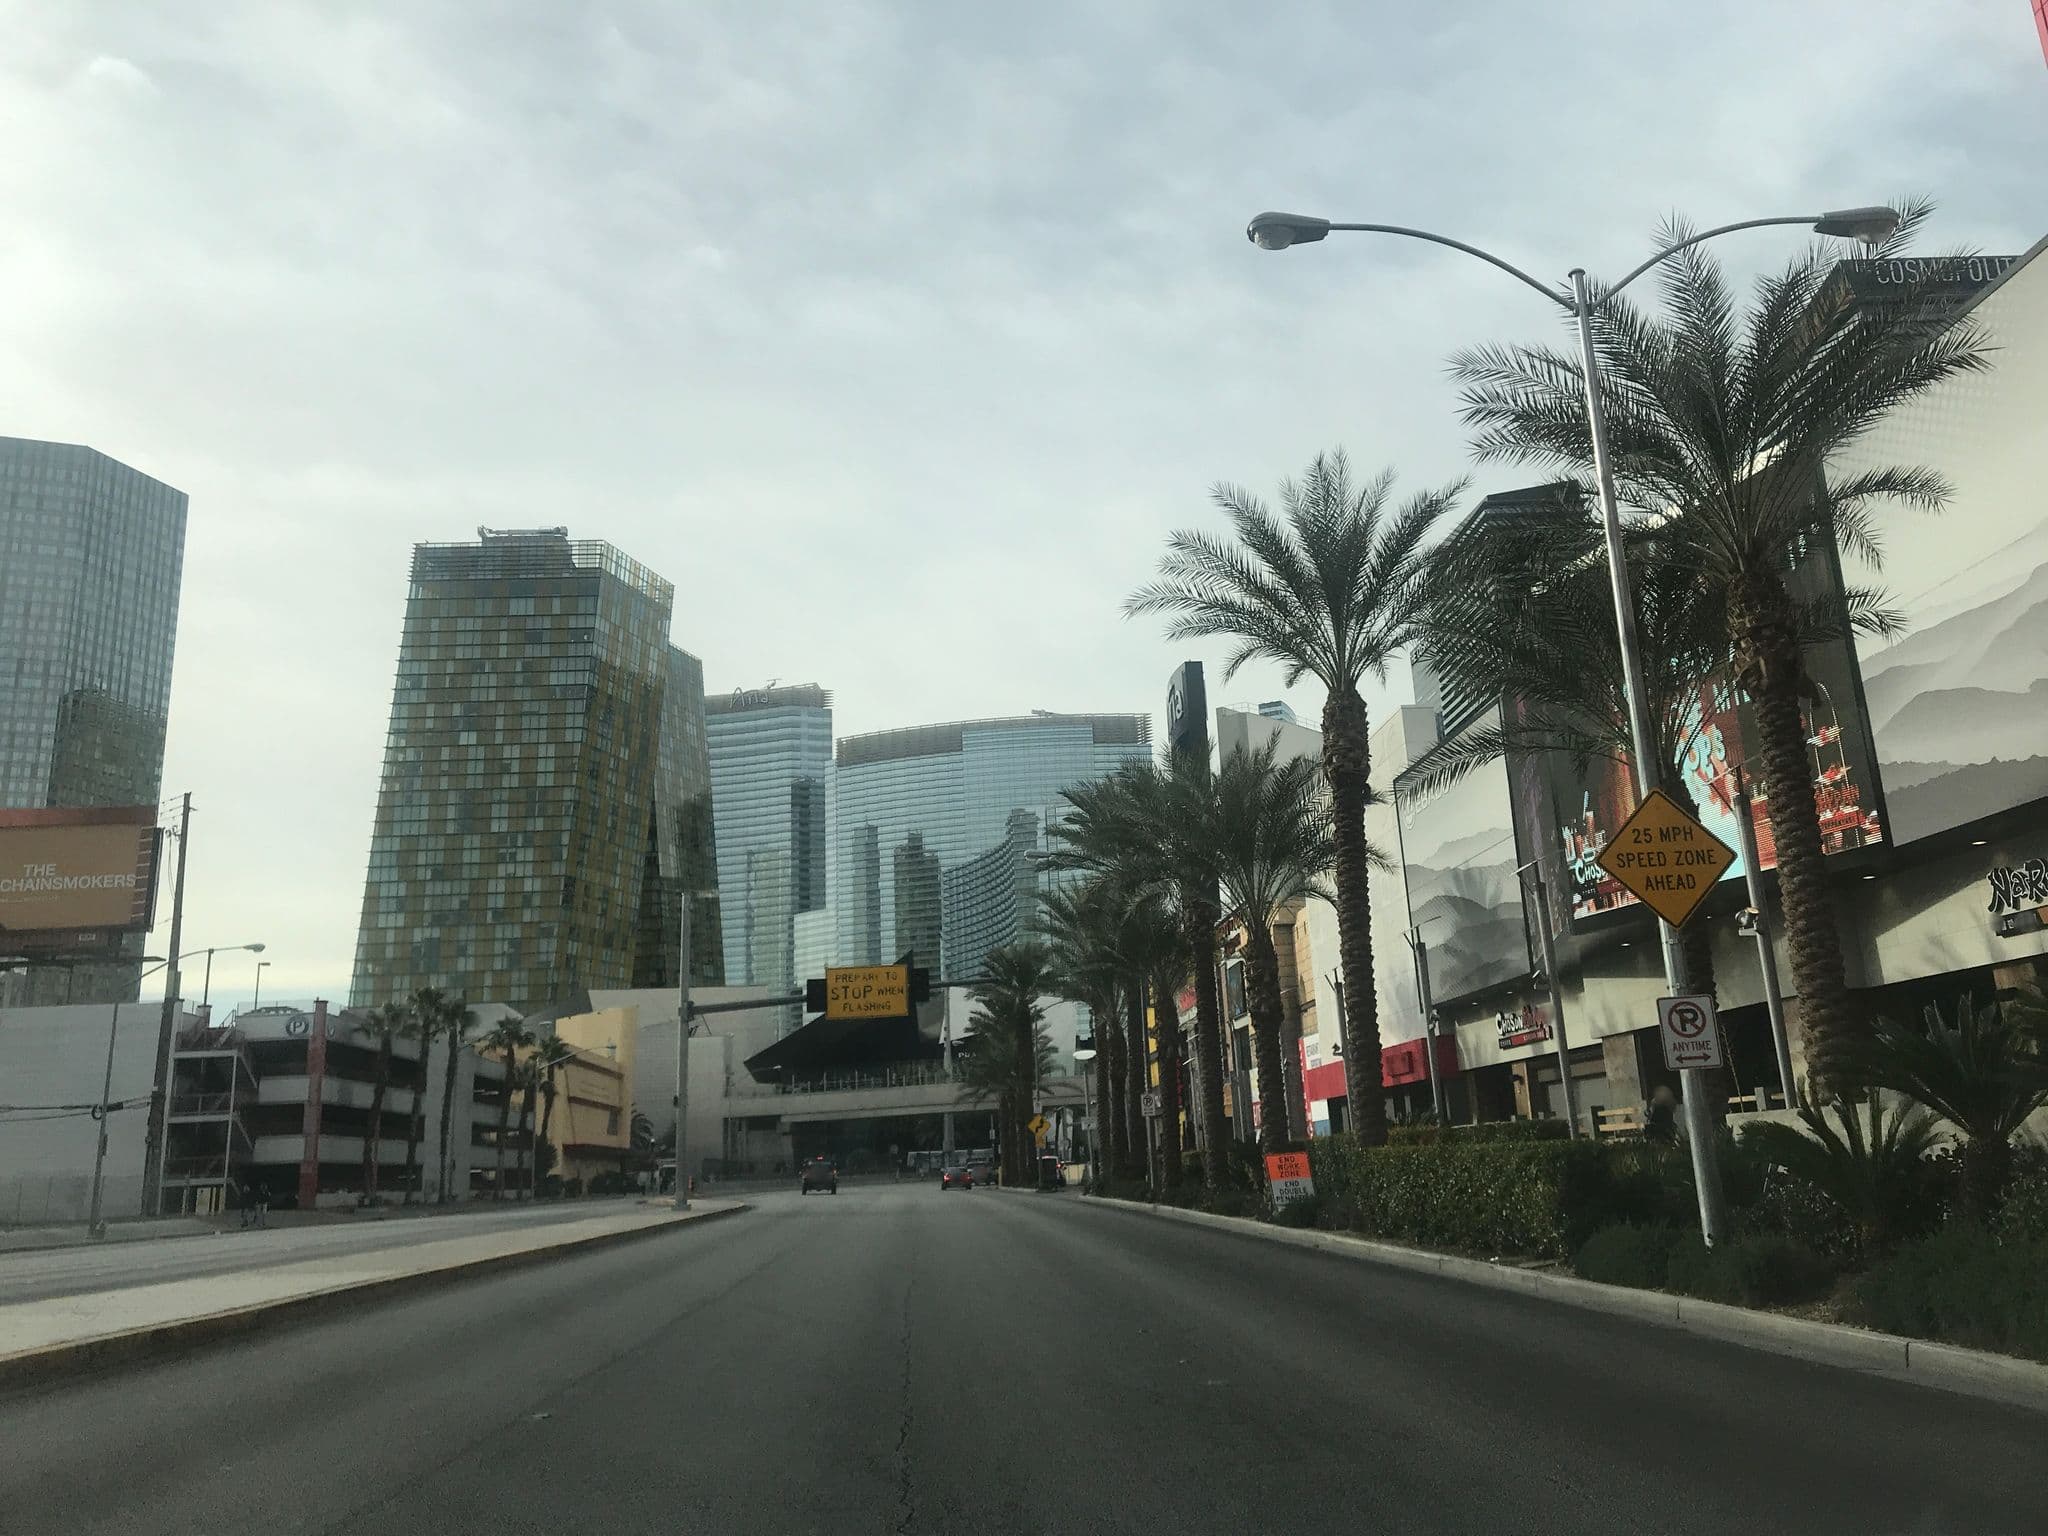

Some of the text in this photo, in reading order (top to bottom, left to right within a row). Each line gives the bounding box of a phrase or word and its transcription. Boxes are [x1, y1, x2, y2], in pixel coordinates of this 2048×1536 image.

[1632, 826, 1694, 844] 25 MPH
[1616, 848, 1717, 869] SPEED ZONE
[23, 863, 57, 877] THE
[0, 873, 137, 893] CHAINSMOKERS
[1645, 873, 1697, 892] AHEAD
[885, 971, 898, 981] TO
[831, 985, 904, 1000] STOP WHEN
[842, 1001, 892, 1012] FLASHING
[1672, 1040, 1712, 1053] ANYTIME
[1278, 1155, 1296, 1164] END
